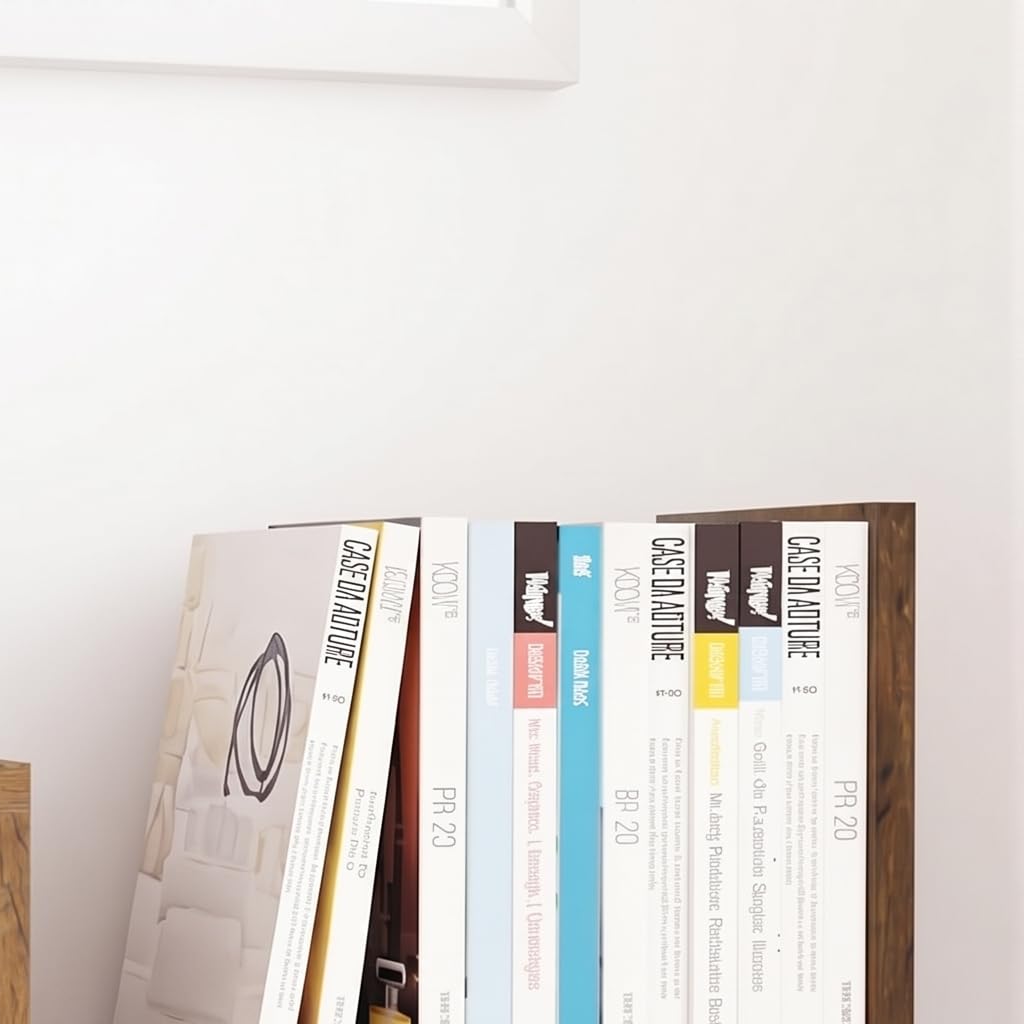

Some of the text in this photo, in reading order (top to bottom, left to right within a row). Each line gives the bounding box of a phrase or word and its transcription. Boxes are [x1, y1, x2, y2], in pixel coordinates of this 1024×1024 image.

[339, 538, 372, 581] CASE
[651, 537, 685, 575] CASE
[787, 536, 821, 574] CASE
[432, 787, 457, 814] PR
[834, 780, 858, 841] PR 20
[615, 820, 640, 845] 20
